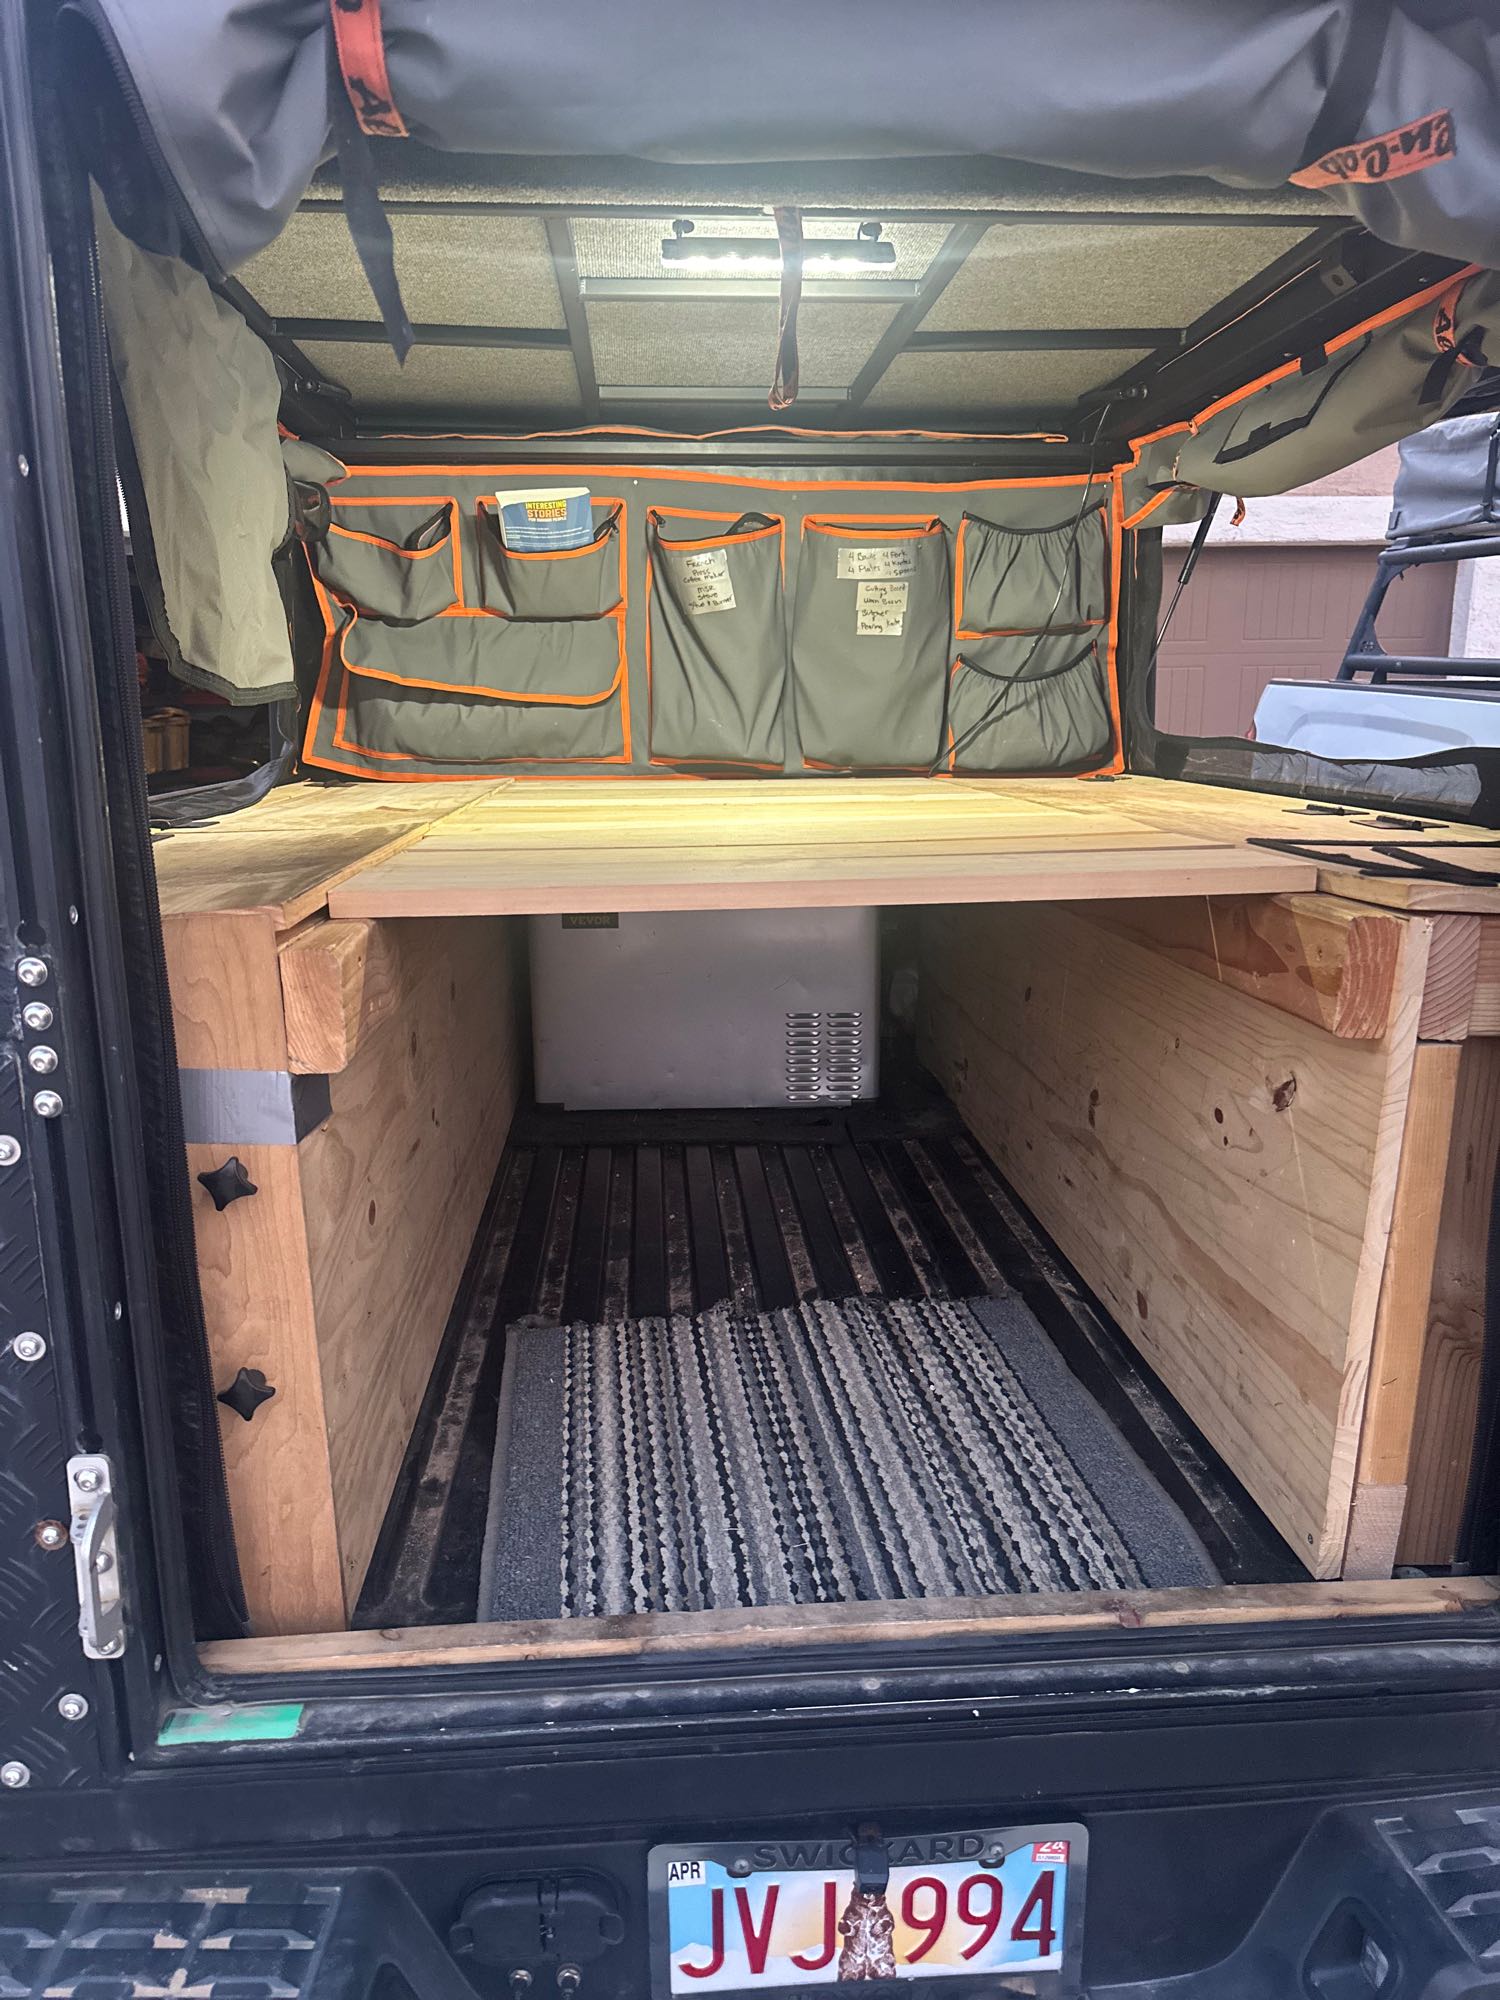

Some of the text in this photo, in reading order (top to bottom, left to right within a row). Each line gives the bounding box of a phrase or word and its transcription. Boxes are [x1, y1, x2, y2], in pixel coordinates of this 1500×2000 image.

[526, 500, 566, 509] INTERESTING
[527, 508, 567, 518] STORIES
[686, 558, 715, 568] French
[569, 915, 610, 925] VEVOR
[753, 1834, 986, 1869] SWICARD
[669, 1862, 700, 1881] APR
[678, 1870, 1056, 1978] JVJ 994
